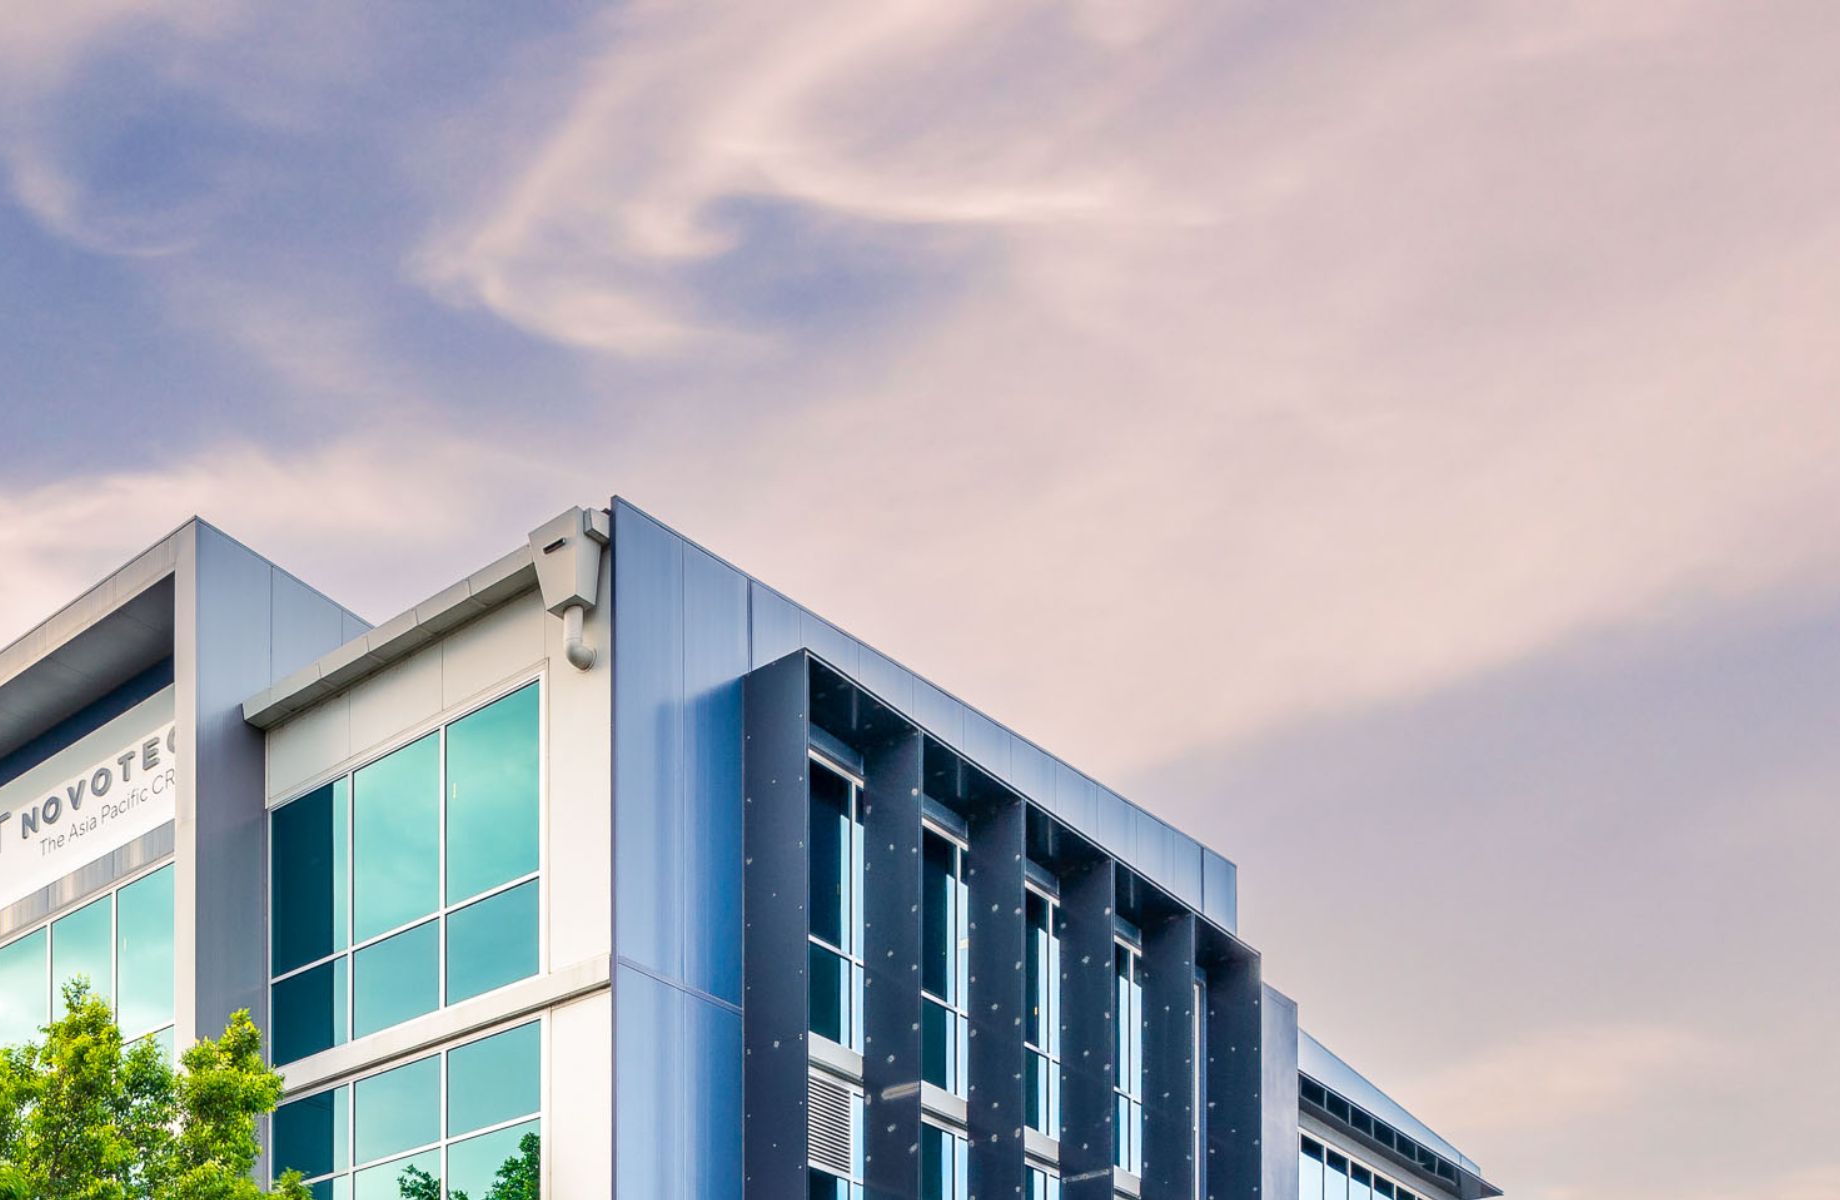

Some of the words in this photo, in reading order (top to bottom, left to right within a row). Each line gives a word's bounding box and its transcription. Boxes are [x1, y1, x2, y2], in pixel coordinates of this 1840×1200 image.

[40, 834, 65, 856] The
[69, 816, 97, 843] Asia
[101, 788, 148, 824] Pacific
